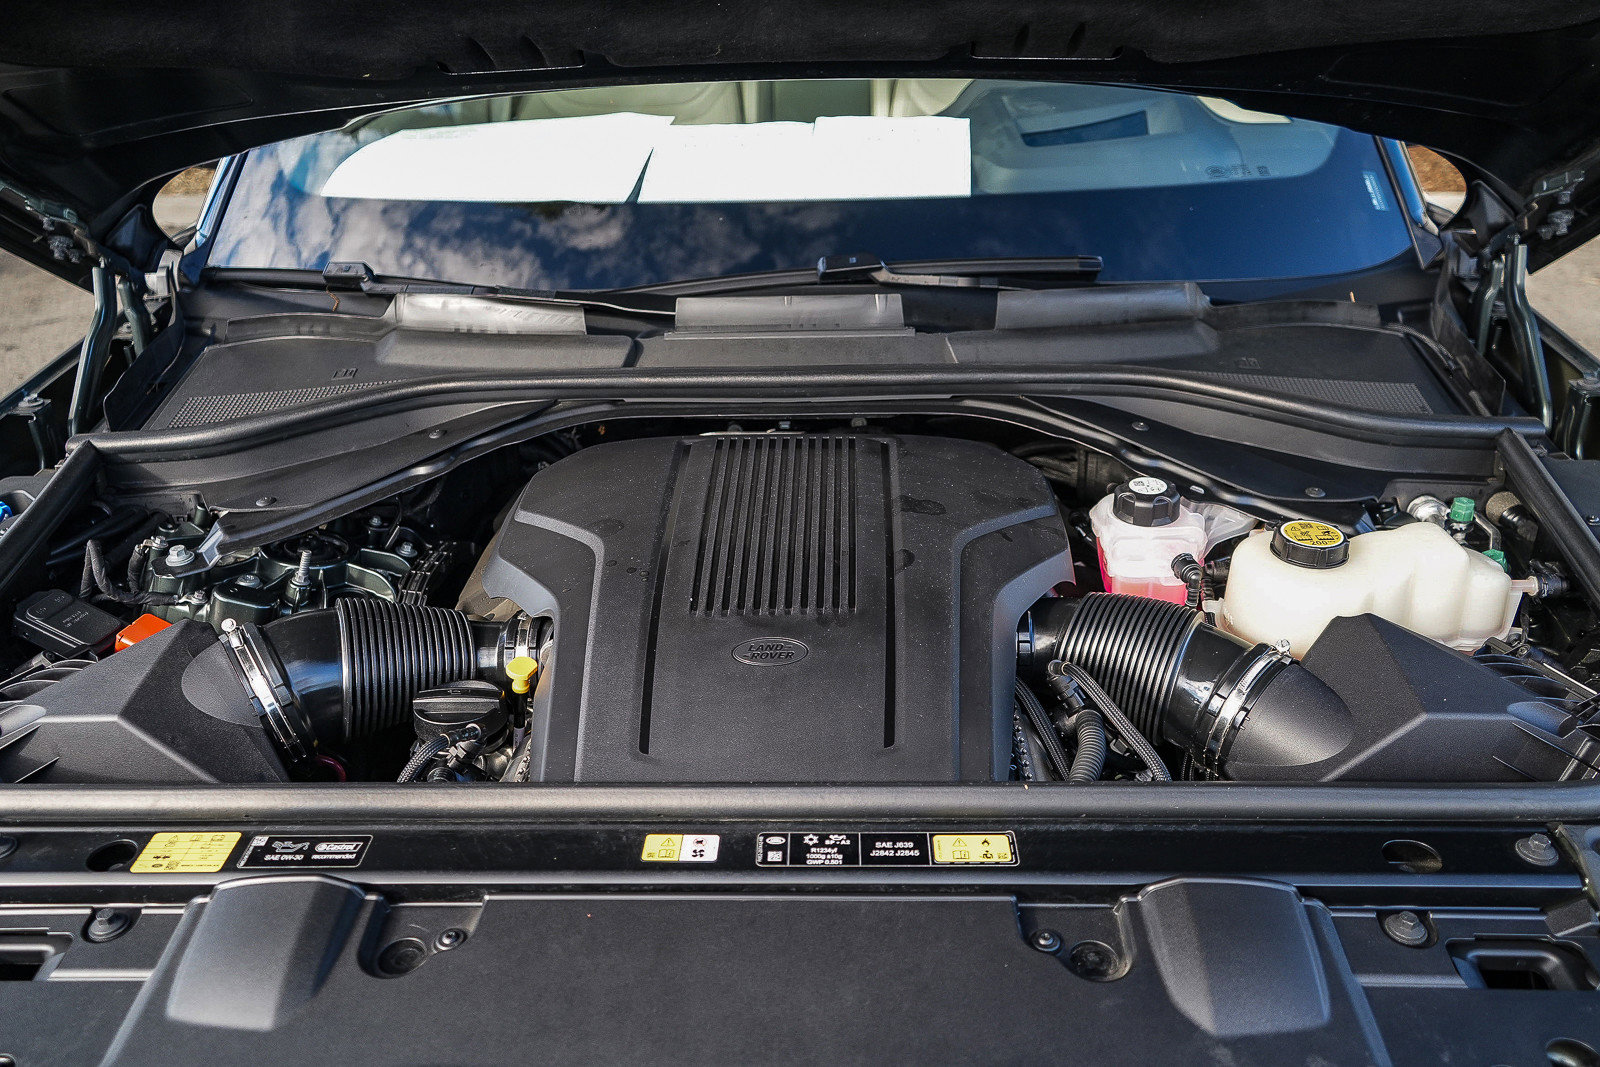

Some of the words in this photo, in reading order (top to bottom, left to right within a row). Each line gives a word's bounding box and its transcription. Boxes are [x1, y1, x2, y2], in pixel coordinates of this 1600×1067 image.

[748, 643, 784, 652] LAND
[750, 651, 795, 660] ROVER
[326, 843, 357, 851] Castrol
[869, 849, 895, 857] J2842
[895, 849, 920, 857] J2845
